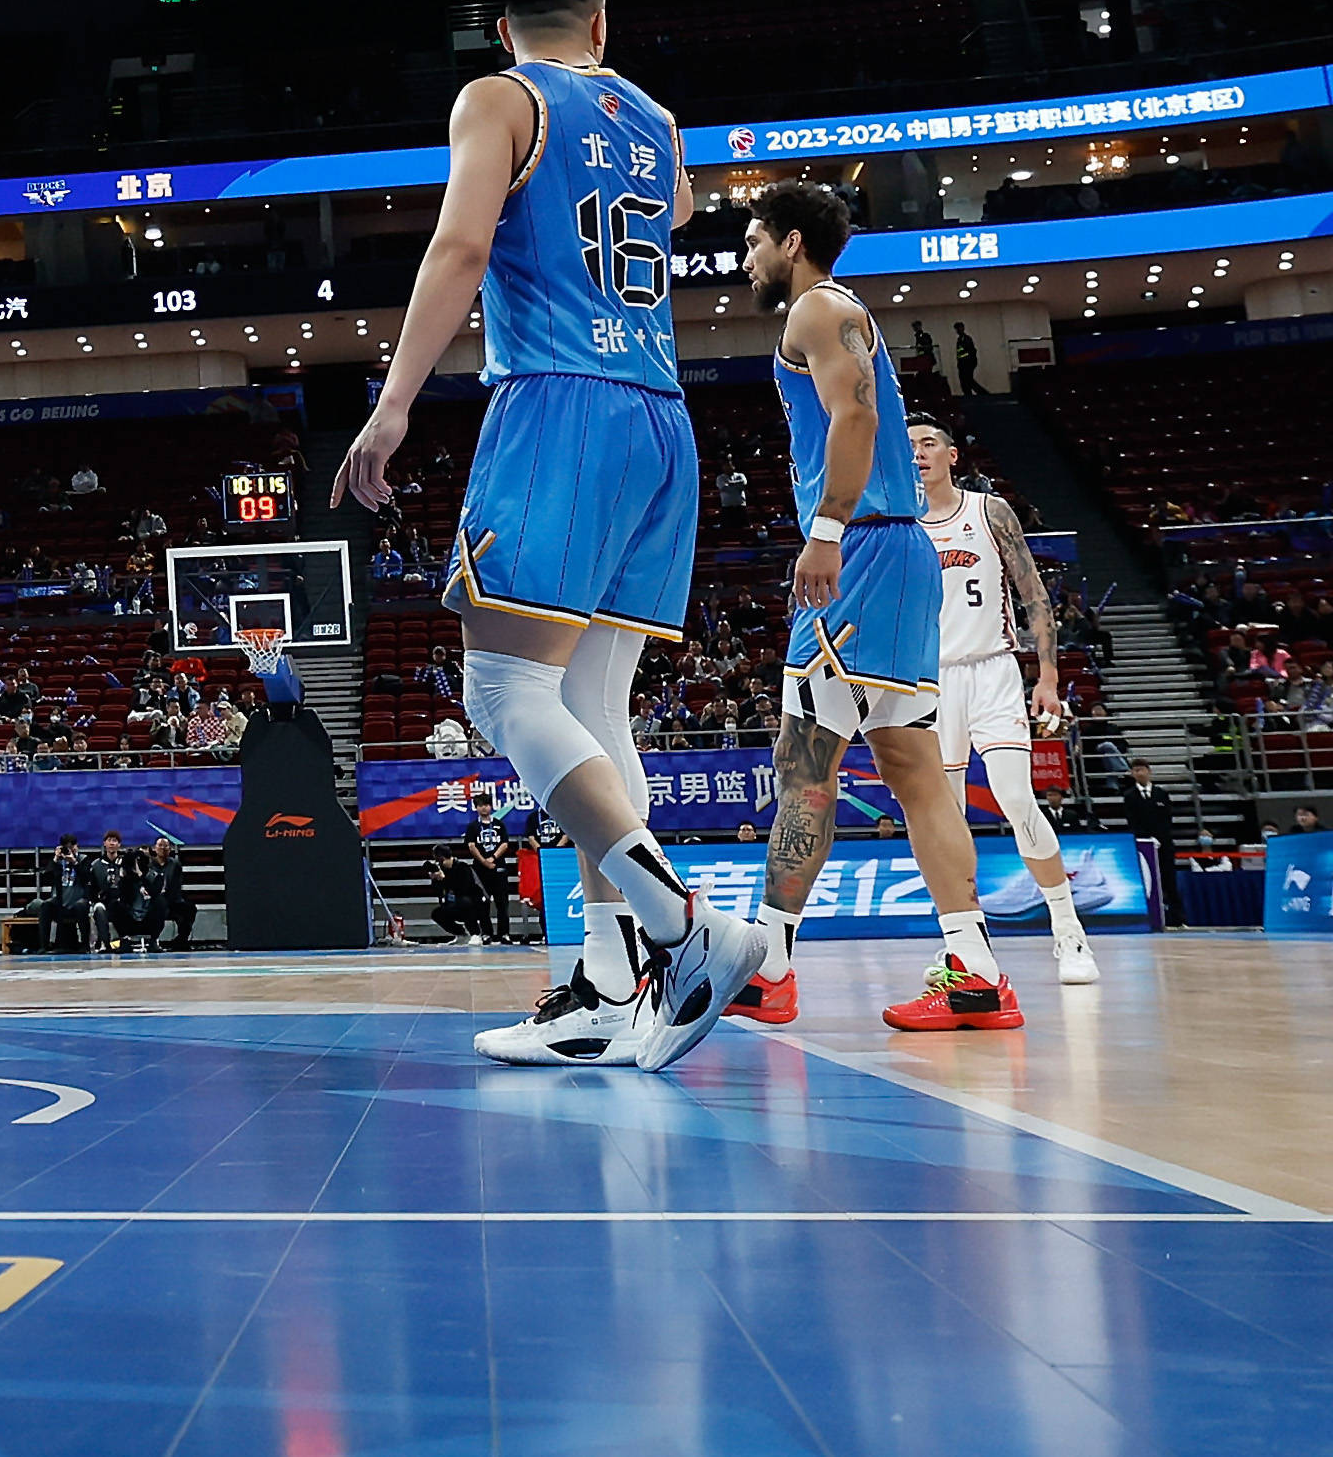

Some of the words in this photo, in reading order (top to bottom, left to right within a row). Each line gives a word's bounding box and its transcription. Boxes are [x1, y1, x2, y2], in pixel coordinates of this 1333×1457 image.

[765, 126, 902, 151] 2023-2024
[117, 173, 172, 200] 北京
[576, 189, 668, 309] 16
[921, 233, 999, 263] 以城之名
[153, 290, 197, 313] 103
[317, 279, 334, 301] 4
[10, 408, 34, 421] GO
[41, 404, 100, 419] BEIJING
[240, 496, 274, 520] 09
[965, 579, 983, 607] 5
[265, 828, 315, 838] LI-NING
